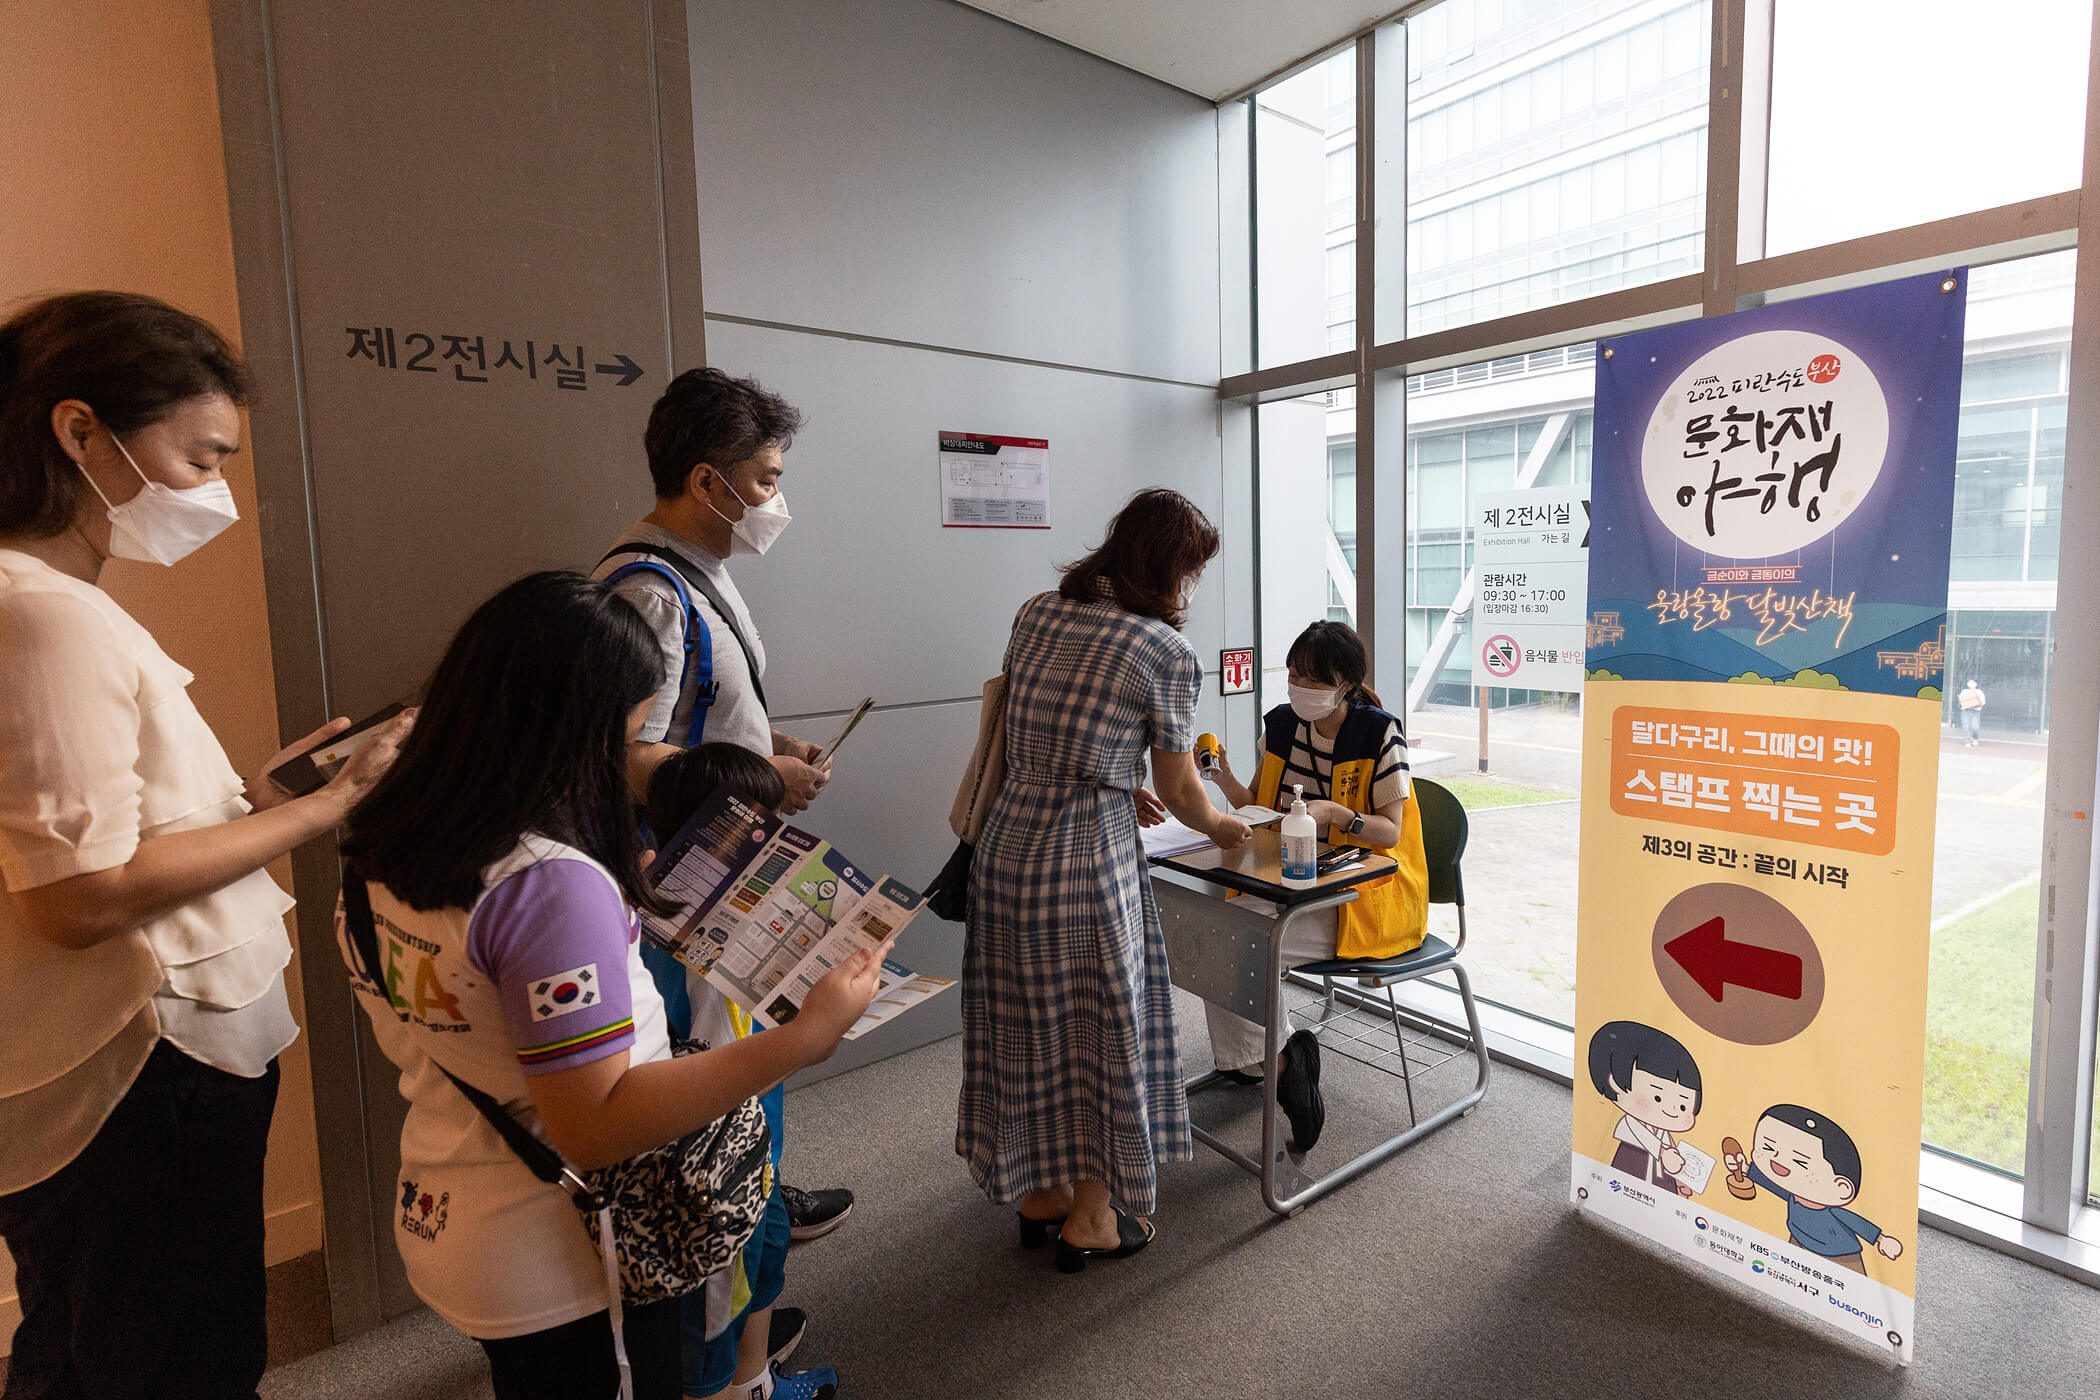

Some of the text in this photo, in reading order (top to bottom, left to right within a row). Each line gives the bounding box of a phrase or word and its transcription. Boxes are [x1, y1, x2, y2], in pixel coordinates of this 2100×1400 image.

[345, 327, 588, 391] 제2전시실
[1687, 358, 1842, 404] 2022 피란수도 부산
[1683, 400, 1834, 459] 문화재
[1676, 432, 1842, 537] 야행
[1483, 537, 1517, 546] Exhibition
[1517, 537, 1531, 545] Hall
[1482, 572, 1528, 588] 관람시간
[1706, 568, 1796, 582] 금순이와 금동이의
[1483, 589, 1517, 602] 09:30
[1531, 589, 1566, 601] 17:00
[1482, 603, 1549, 615] (입장마감 16:30)
[1225, 653, 1251, 663] 소화기
[1524, 649, 1559, 664] 음식물
[1630, 720, 1873, 766] 달다구리, 그때의 맛!
[1623, 768, 1878, 836] 스탬프 찍는 곳
[1641, 834, 1692, 861] 제3의
[1697, 843, 1738, 869] 공간
[1754, 852, 1797, 880] 끝의
[1802, 862, 1850, 889] 시작
[400, 1214, 438, 1244] RERUN
[1750, 1241, 1770, 1257] KBS
[1797, 1281, 1820, 1297] 서구
[1828, 1293, 1884, 1328] busanjin
